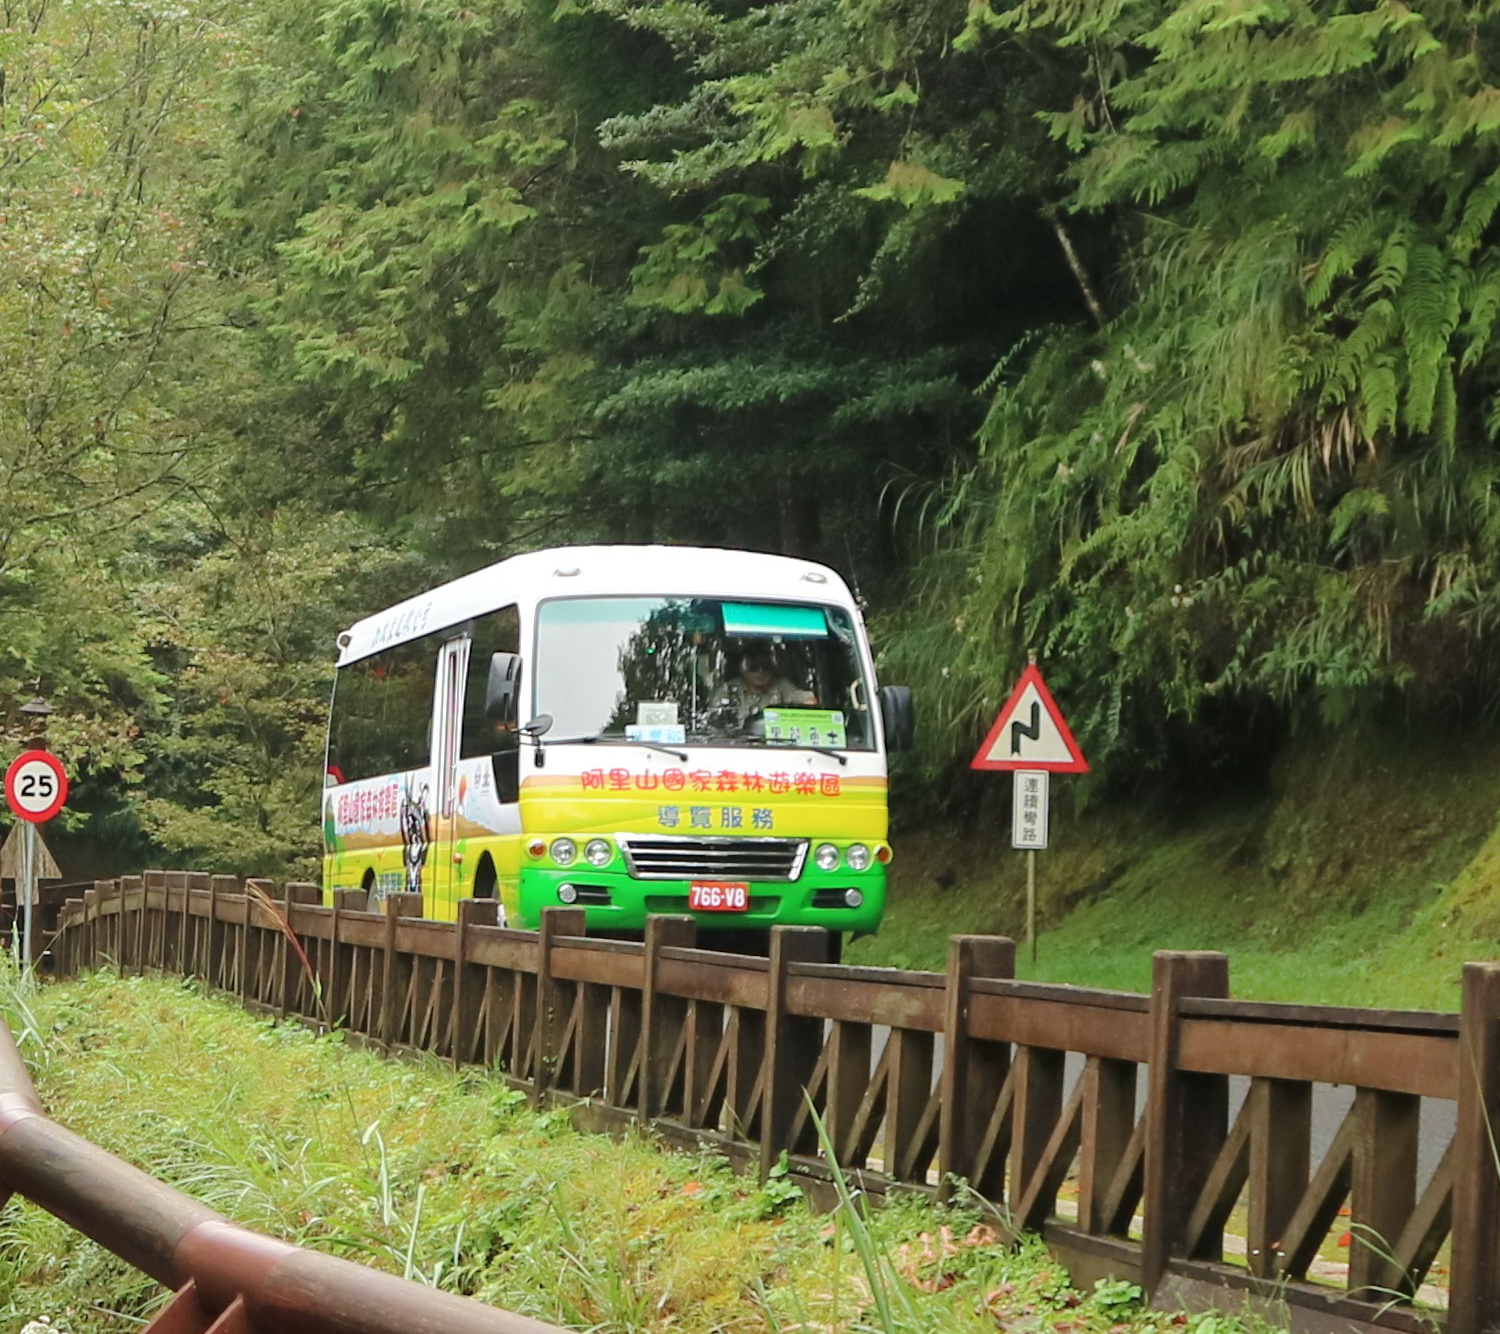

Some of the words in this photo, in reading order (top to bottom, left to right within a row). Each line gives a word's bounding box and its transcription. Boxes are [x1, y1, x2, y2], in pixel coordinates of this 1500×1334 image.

[21, 775, 52, 797] 25
[580, 767, 841, 797] 阿里山國家森林遊樂區
[657, 805, 775, 830] 導覽服務
[1023, 777, 1039, 842] 連續彎路
[691, 886, 745, 908] 766-V8
